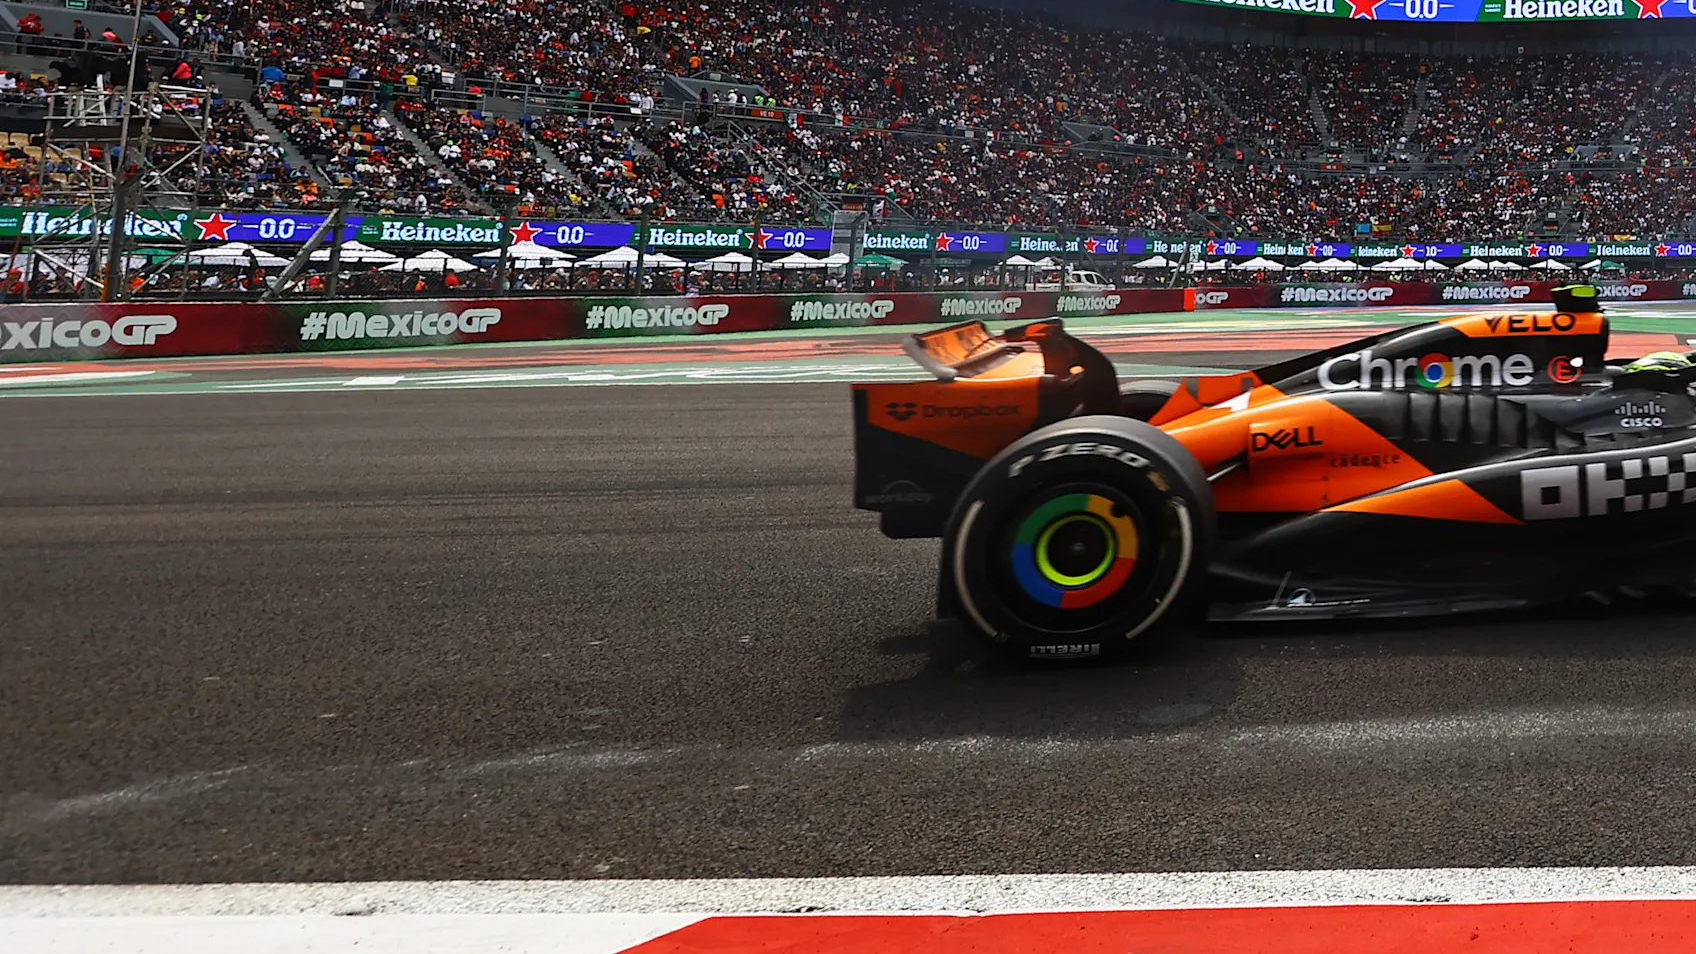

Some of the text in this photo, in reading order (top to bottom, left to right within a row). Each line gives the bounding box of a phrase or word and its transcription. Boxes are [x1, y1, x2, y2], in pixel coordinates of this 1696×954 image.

[21, 212, 186, 236] Heinken
[259, 218, 295, 238] 0.0
[557, 226, 584, 244] 0.0
[784, 232, 805, 247] 0.0
[962, 236, 979, 249] 0.0
[1020, 237, 1077, 250] Heineen
[1153, 241, 1202, 254] Heneen
[1280, 282, 1393, 302] #MexicoGP
[1442, 286, 1530, 300] #MexicoGP
[790, 300, 894, 321] #MexicoGP
[941, 298, 1022, 316] #MexicoGP
[1057, 295, 1121, 312] #MexicoGP
[300, 308, 502, 340] #MexicoGP
[586, 304, 729, 330] #MexicoGP
[1484, 313, 1576, 332] VELO
[922, 404, 1020, 419] Dropbox
[1620, 418, 1663, 427] CISCO
[1252, 426, 1323, 452] DELL
[1038, 442, 1151, 469] ZERO
